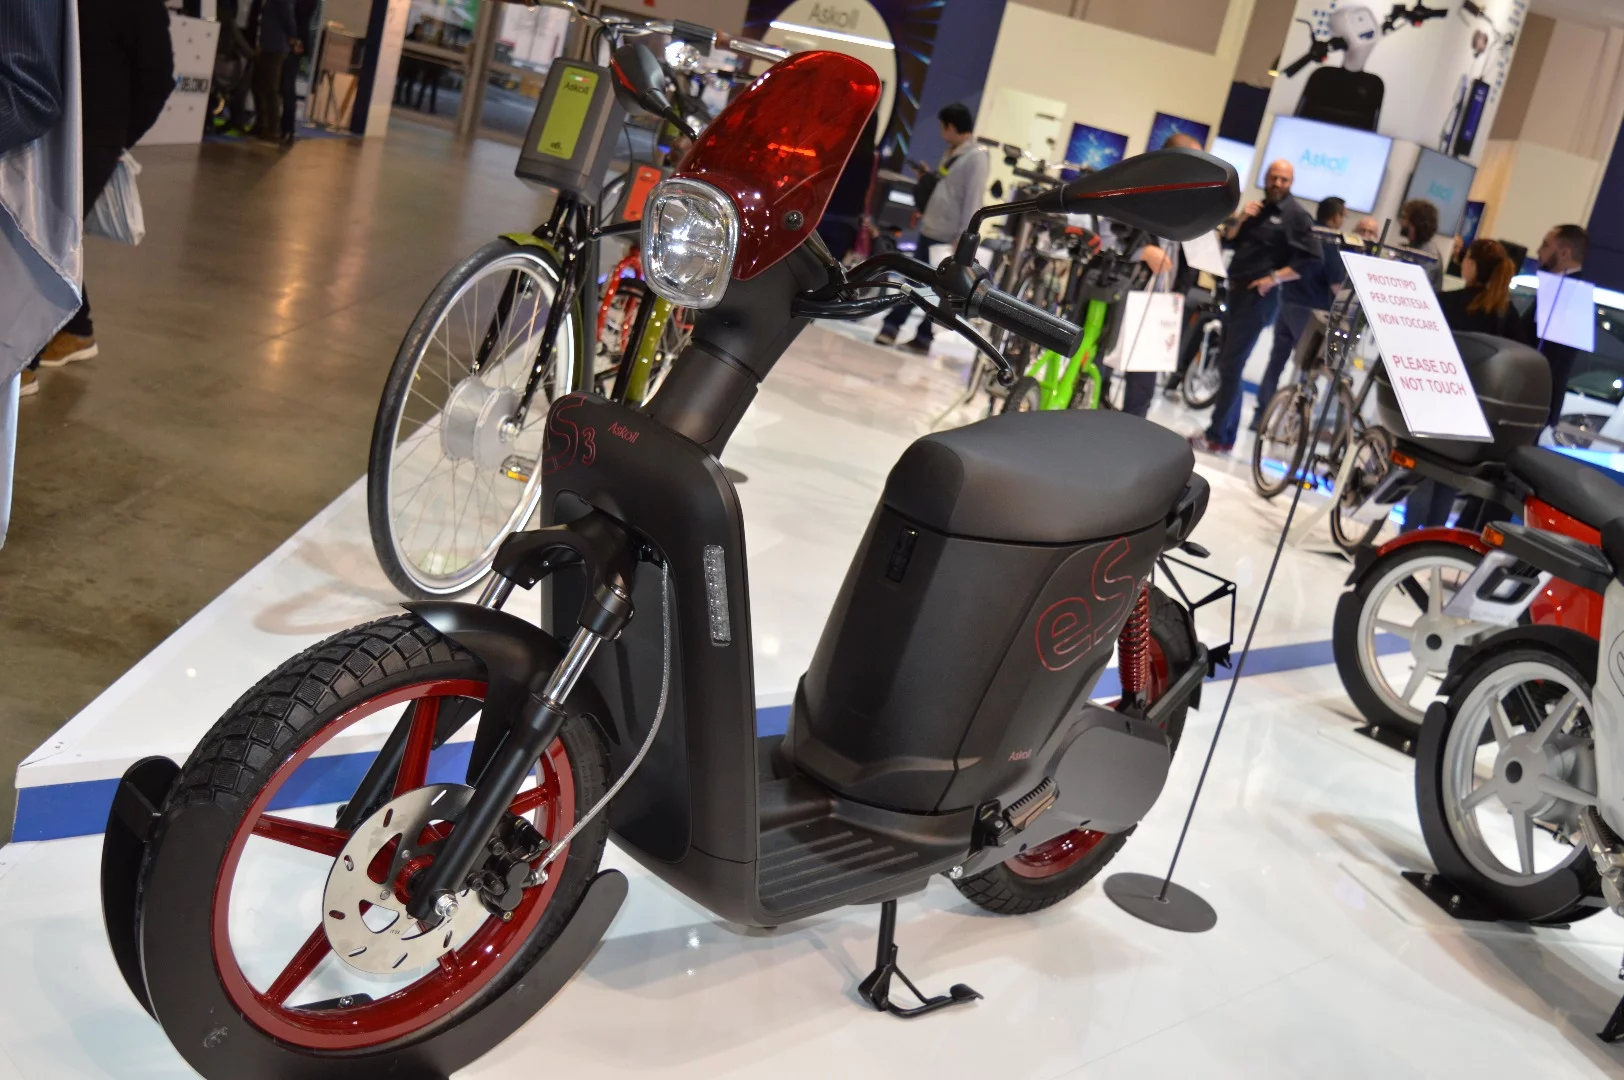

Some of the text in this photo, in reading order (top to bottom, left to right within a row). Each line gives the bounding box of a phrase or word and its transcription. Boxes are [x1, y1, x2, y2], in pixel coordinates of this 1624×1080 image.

[807, 2, 860, 30] Askoll
[1300, 149, 1350, 173] Askoll
[1367, 272, 1417, 292] PROTOTIPO
[1370, 291, 1431, 311] PER CORTESIA
[1377, 312, 1440, 332] NON TOCCARE
[1392, 355, 1457, 375] PLEASE DO
[1400, 376, 1467, 397] NOT TOUCH
[607, 421, 640, 444] Askoll
[1035, 536, 1148, 672] eS
